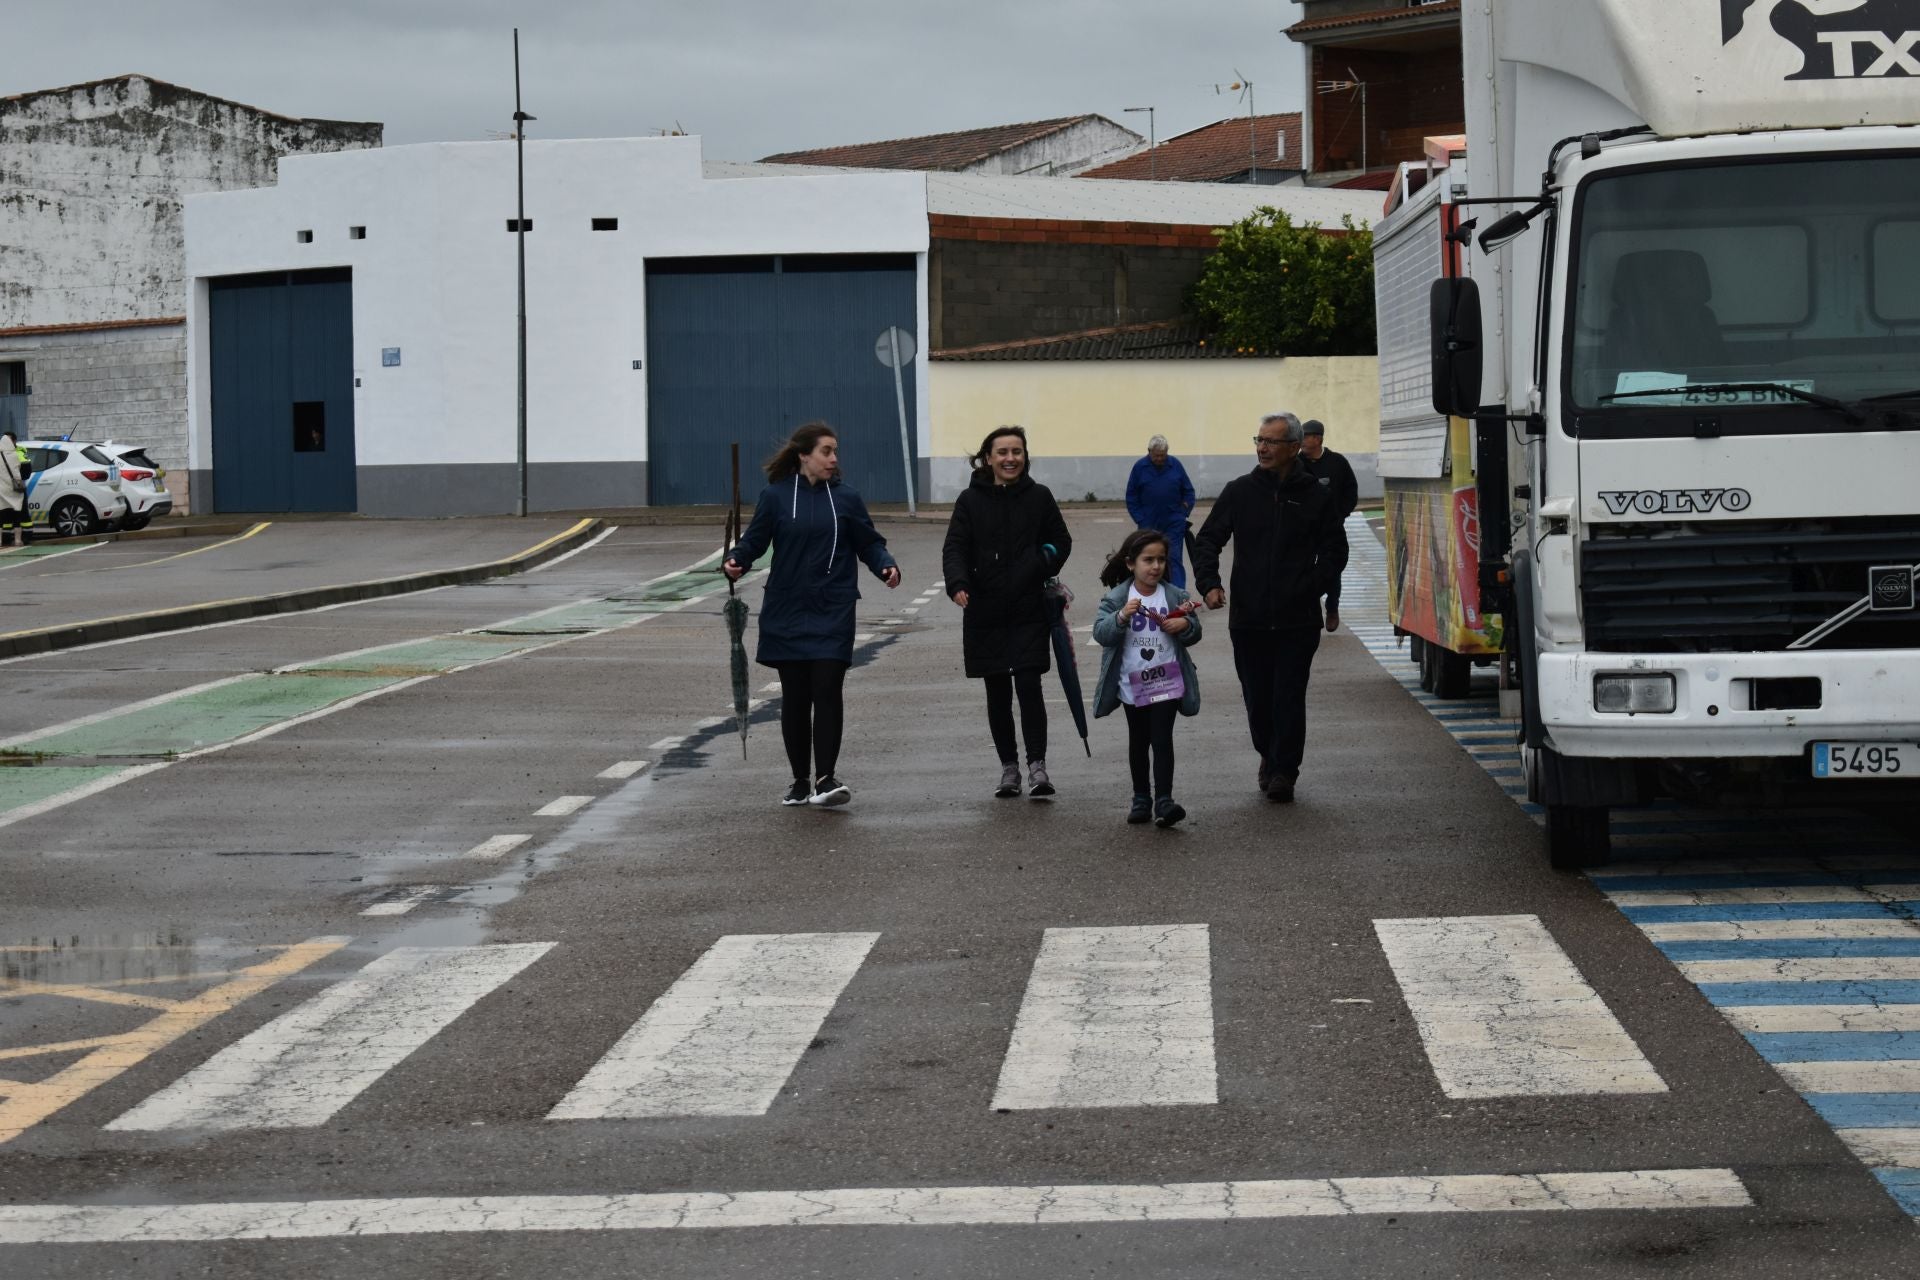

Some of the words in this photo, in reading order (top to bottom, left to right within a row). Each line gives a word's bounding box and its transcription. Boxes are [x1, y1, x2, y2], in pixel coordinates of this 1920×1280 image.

[1598, 488, 1751, 514] VOLVO
[1141, 665, 1165, 681] 020
[1818, 763, 1825, 771] E
[1831, 747, 1901, 773] 5495
